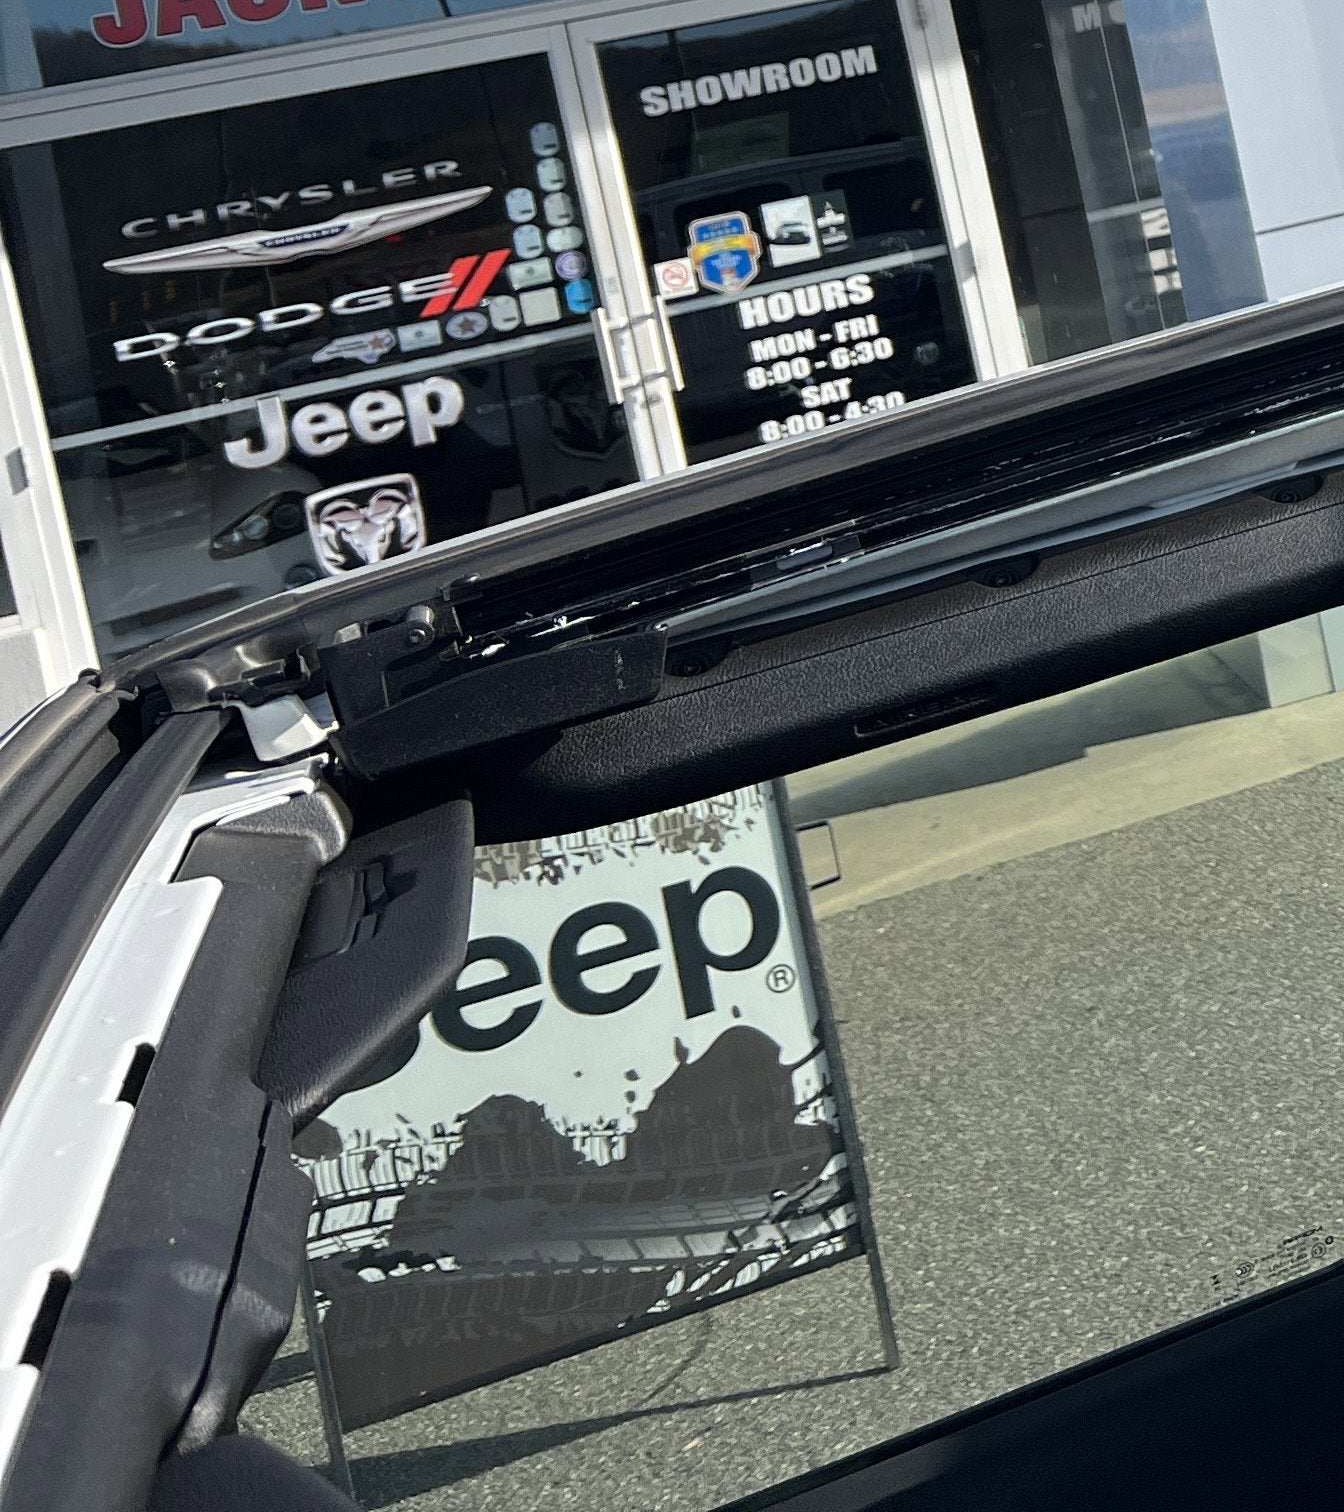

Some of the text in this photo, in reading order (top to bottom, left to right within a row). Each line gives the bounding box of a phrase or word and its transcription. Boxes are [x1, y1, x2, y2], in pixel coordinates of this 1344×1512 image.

[638, 44, 878, 118] SHOWROOM
[121, 159, 462, 239] CHRYSLER
[113, 271, 458, 363] DODGE
[738, 273, 875, 330] HOURS
[745, 356, 812, 390] 8:00
[829, 336, 895, 371] 6:30
[749, 328, 817, 363] MON
[834, 314, 880, 343] FRI
[800, 377, 853, 408] SAT
[224, 376, 464, 469] Jeep
[758, 410, 826, 443] 8:00
